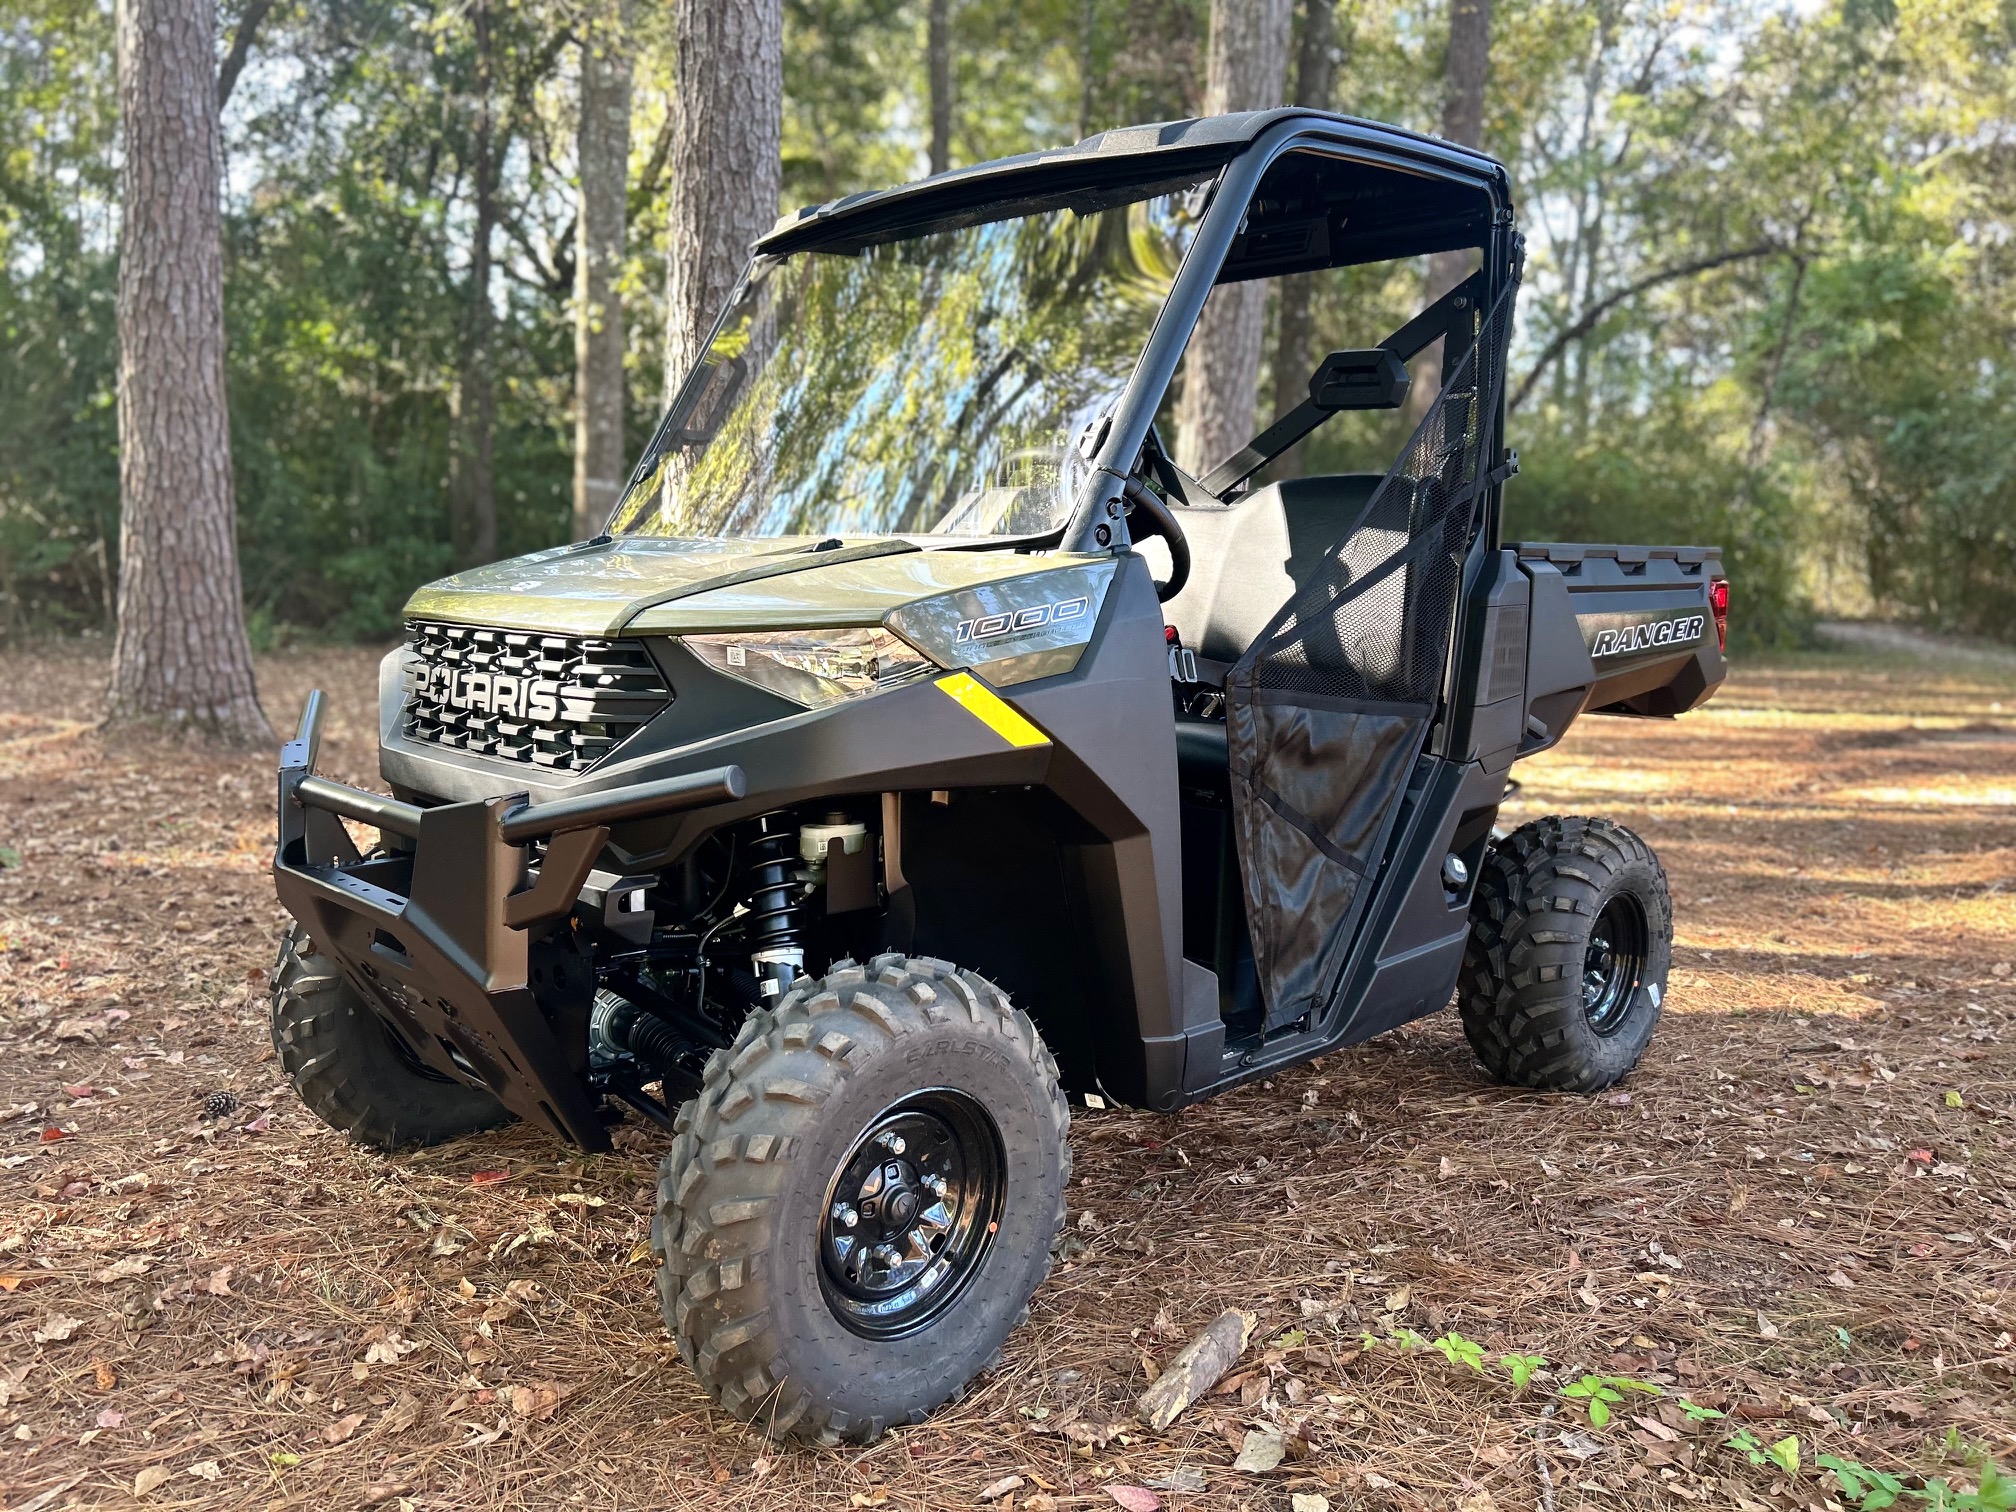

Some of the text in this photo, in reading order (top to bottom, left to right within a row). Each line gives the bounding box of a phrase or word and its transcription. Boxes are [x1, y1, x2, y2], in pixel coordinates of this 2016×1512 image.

[955, 597, 1088, 643] 1000
[1591, 615, 1703, 657] RANGER
[409, 663, 558, 721] POLARIS
